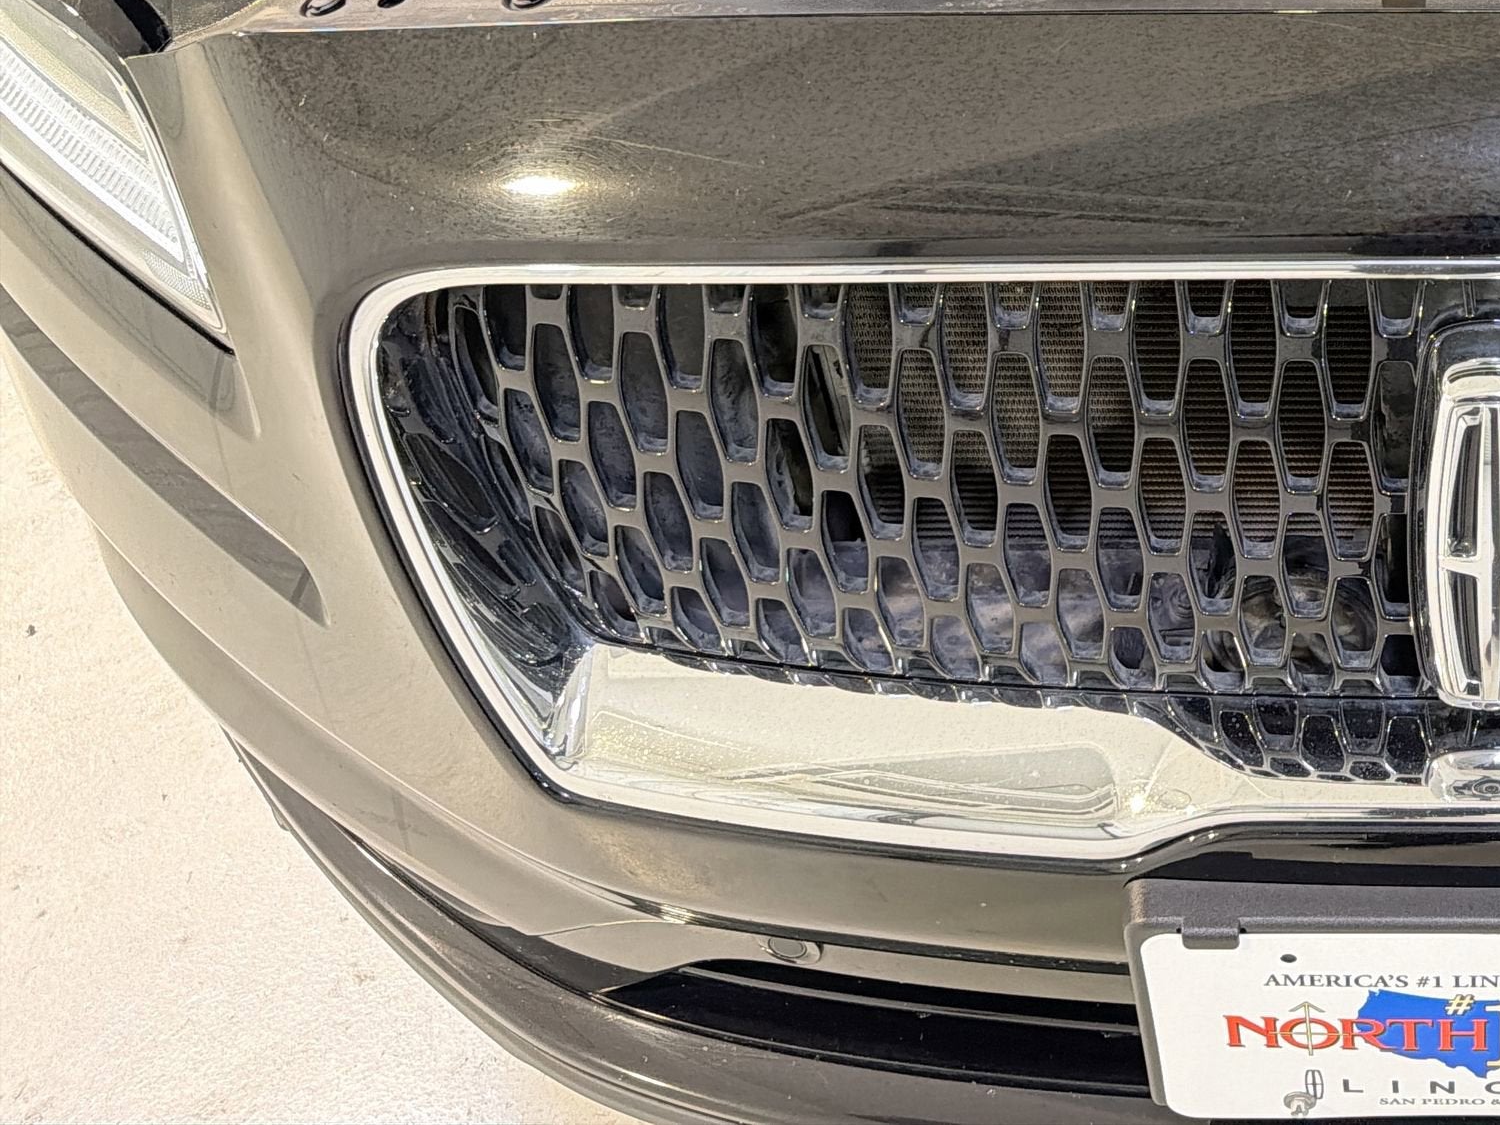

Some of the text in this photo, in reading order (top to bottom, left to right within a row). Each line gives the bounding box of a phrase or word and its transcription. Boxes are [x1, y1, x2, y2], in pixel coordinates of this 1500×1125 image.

[1264, 974, 1408, 988] AMERICA'S
[1416, 975, 1443, 988] #1
[1222, 1014, 1488, 1052] NORTH
[1379, 1097, 1416, 1106] SAN
[1421, 1098, 1486, 1106] PEDRO
